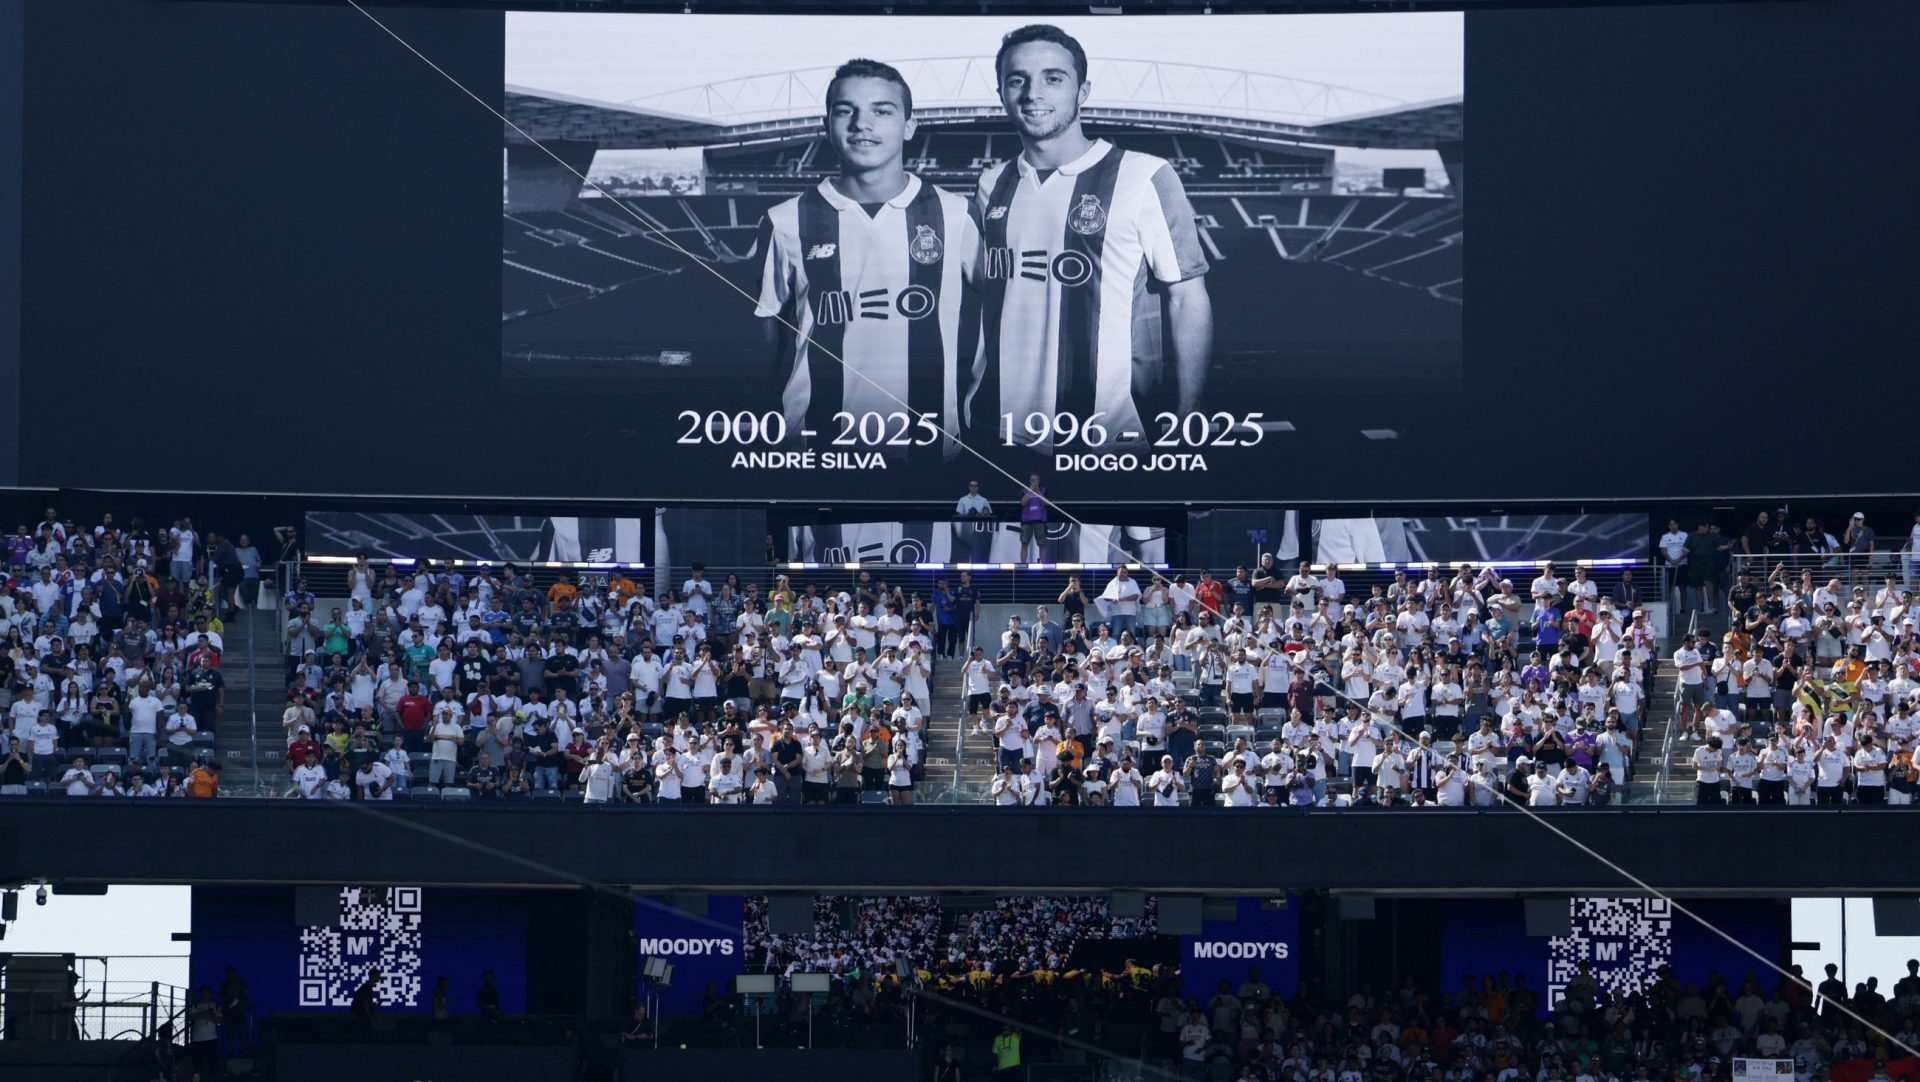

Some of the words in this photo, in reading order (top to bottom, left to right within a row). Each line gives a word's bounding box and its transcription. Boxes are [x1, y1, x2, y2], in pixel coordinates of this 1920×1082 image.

[987, 247, 1093, 287] MEO
[817, 284, 935, 325] MEO
[676, 410, 787, 445] 2000
[831, 411, 939, 446] 2025
[1000, 411, 1108, 447] 1996
[1153, 411, 1265, 447] 2025
[731, 448, 816, 469] ANDRÉ
[820, 452, 887, 469] SILVA
[1055, 453, 1138, 472] DIOGO
[1142, 453, 1208, 472] JOTA
[640, 938, 734, 956] MOODY'S
[1193, 942, 1289, 959] MOODY'S
